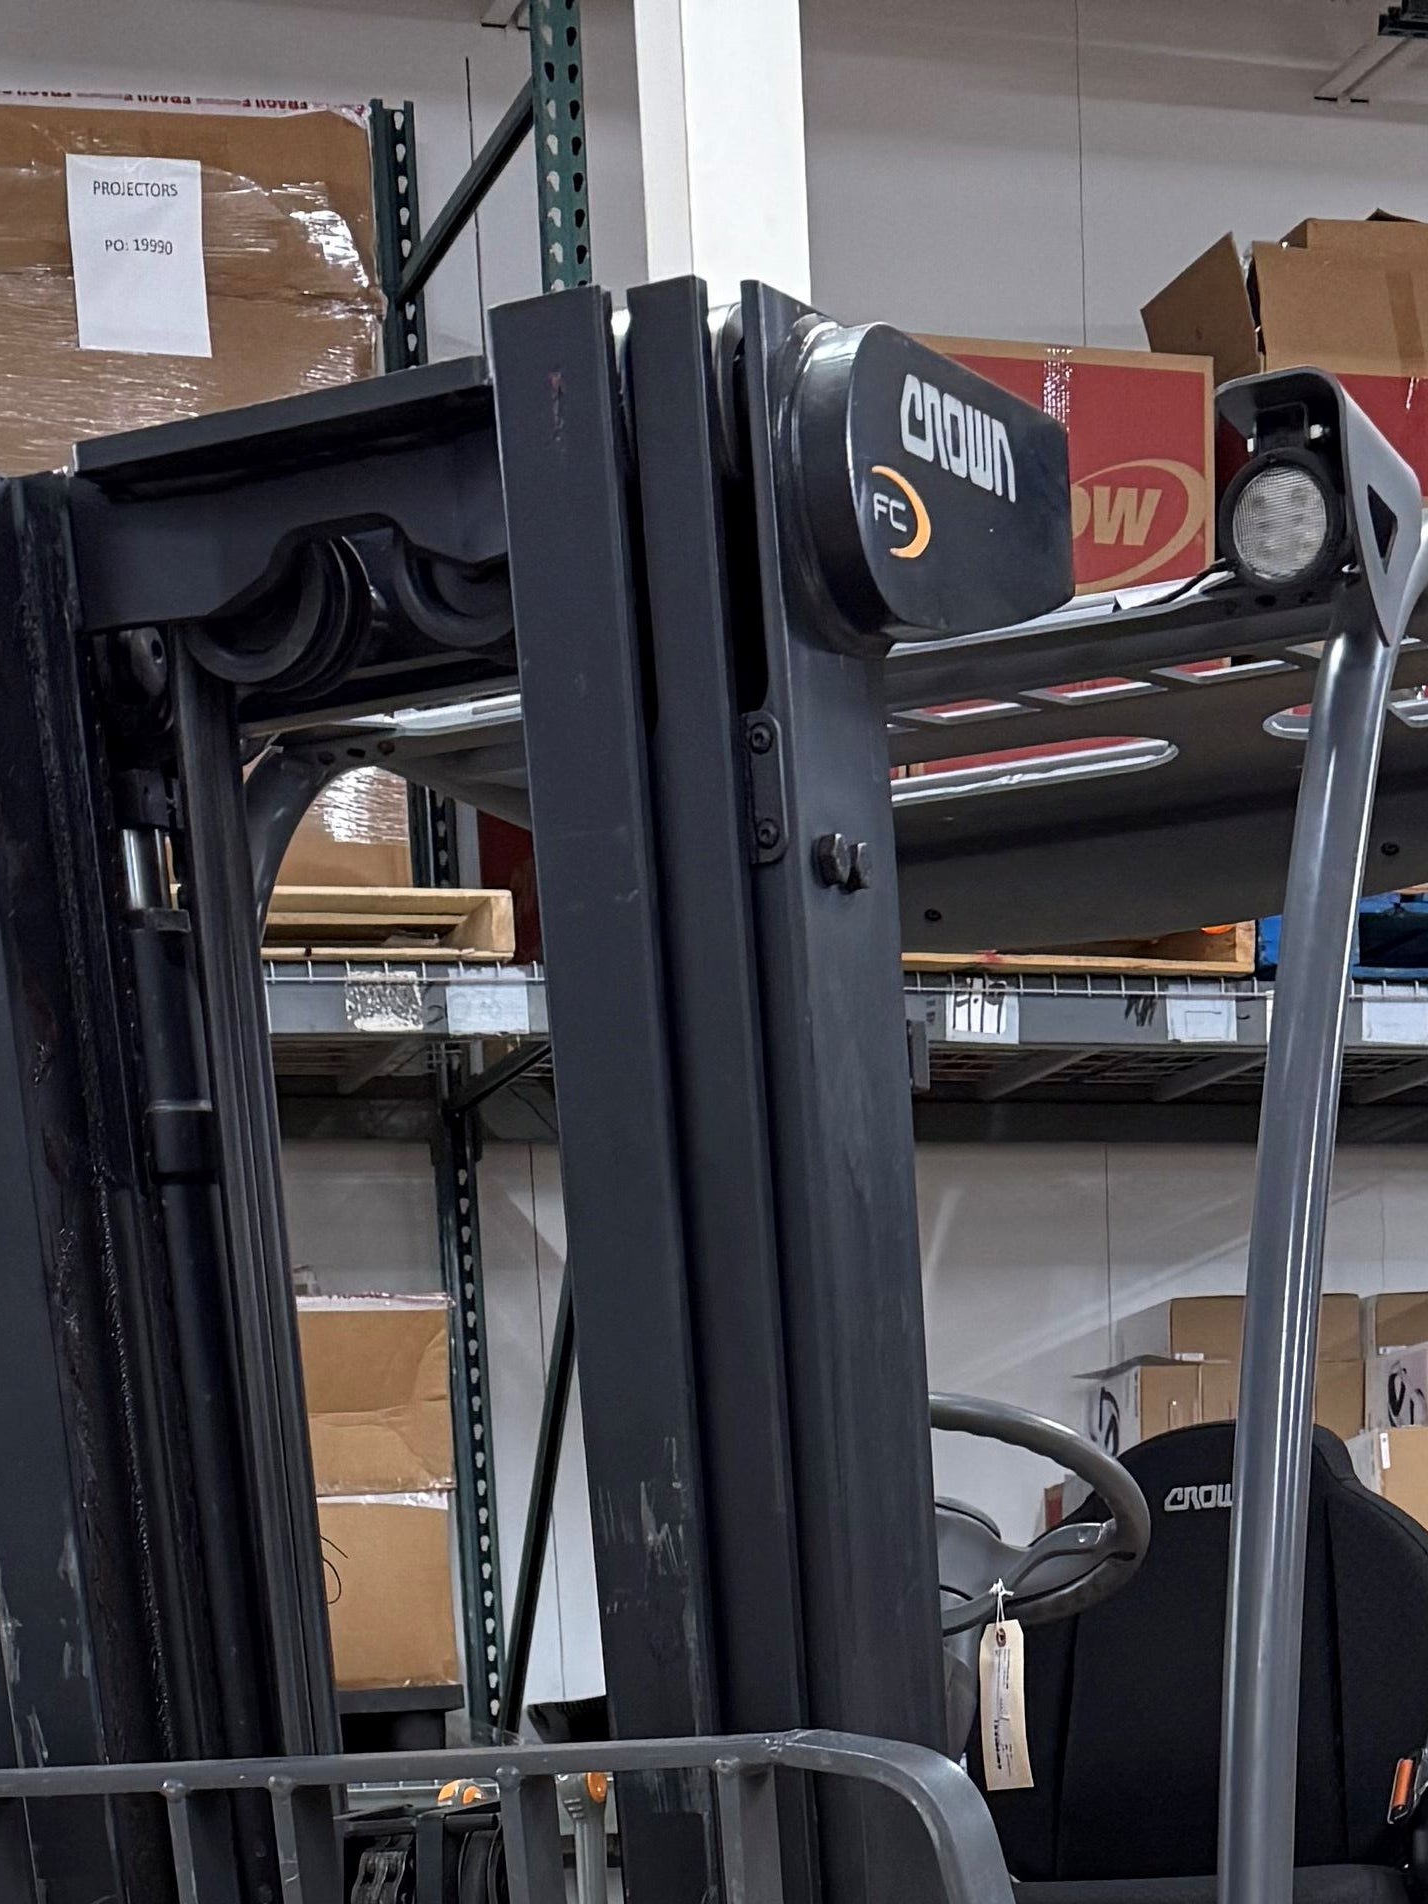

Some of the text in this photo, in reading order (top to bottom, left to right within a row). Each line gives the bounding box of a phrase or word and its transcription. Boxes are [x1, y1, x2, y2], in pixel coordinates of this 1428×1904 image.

[93, 180, 177, 198] PROJECTORS
[105, 238, 174, 256] PO: 19990
[900, 373, 1016, 503] CROWN
[873, 493, 907, 533] FC
[1164, 1483, 1232, 1511] CROW
